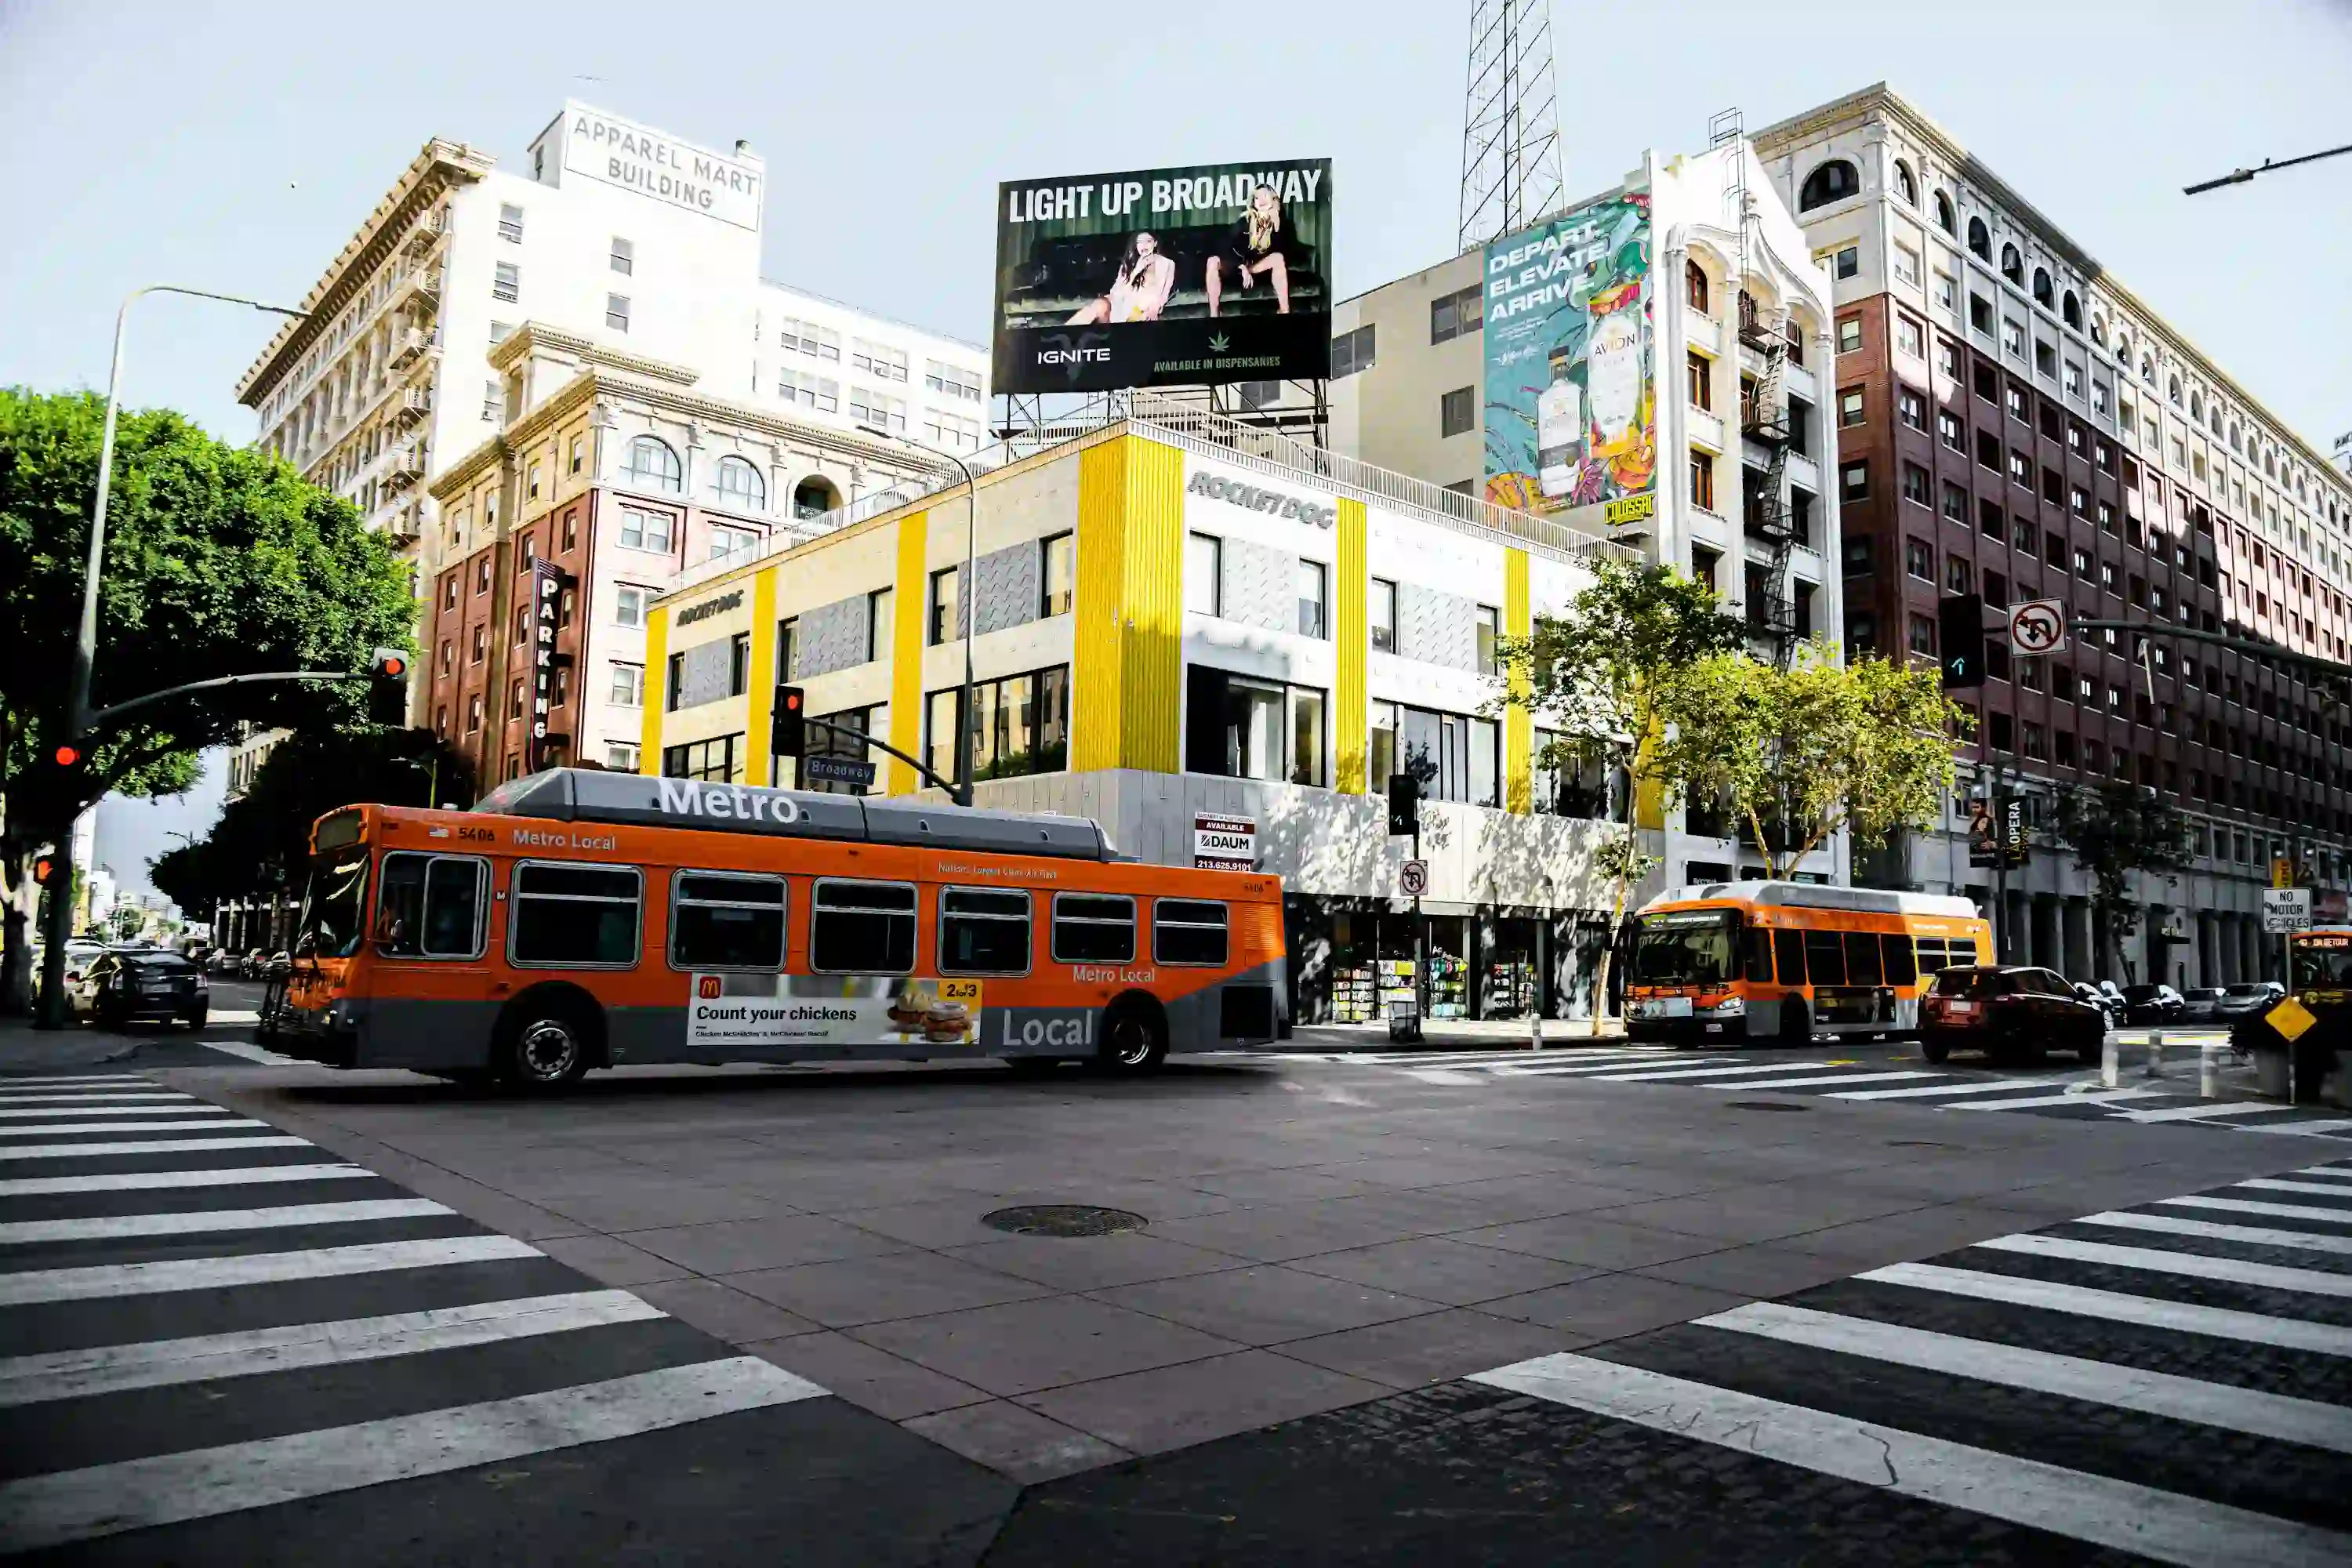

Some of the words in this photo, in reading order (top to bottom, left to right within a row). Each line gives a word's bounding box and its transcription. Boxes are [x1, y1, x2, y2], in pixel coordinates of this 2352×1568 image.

[573, 116, 681, 171] APPAREL
[693, 158, 757, 197] MART
[608, 158, 713, 210] BUILDING
[1009, 185, 1094, 223] LIGHT
[1102, 182, 1143, 216] UP
[1152, 169, 1323, 213] BROADWAY
[1037, 348, 1111, 365] IGNITE
[1153, 360, 1202, 372] AVAILABLE
[1203, 358, 1213, 370] IN
[1215, 356, 1281, 368] DISPENSARIES
[1603, 494, 1656, 524] COLOSSAL
[534, 579, 558, 739] PARKING
[811, 760, 870, 779] Broadway
[659, 777, 798, 823] Metro
[1206, 822, 1245, 831] AVAILABLE
[2008, 801, 2020, 844] OPERA
[459, 827, 495, 841] 5406
[512, 829, 566, 846] Metro
[572, 833, 615, 851] Local
[1211, 835, 1249, 850] DAUM
[1197, 860, 1251, 872] 213.626.9101
[2279, 891, 2293, 902] NO
[2270, 904, 2303, 915] MOTOR
[2266, 917, 2310, 929] VEHICLES
[1073, 965, 1116, 982] Metro
[1120, 966, 1156, 982] Local
[946, 983, 956, 997] 2
[696, 1006, 747, 1020] Count
[750, 1010, 786, 1024] your
[789, 1006, 857, 1021] chickens
[1003, 1009, 1093, 1046] Local
